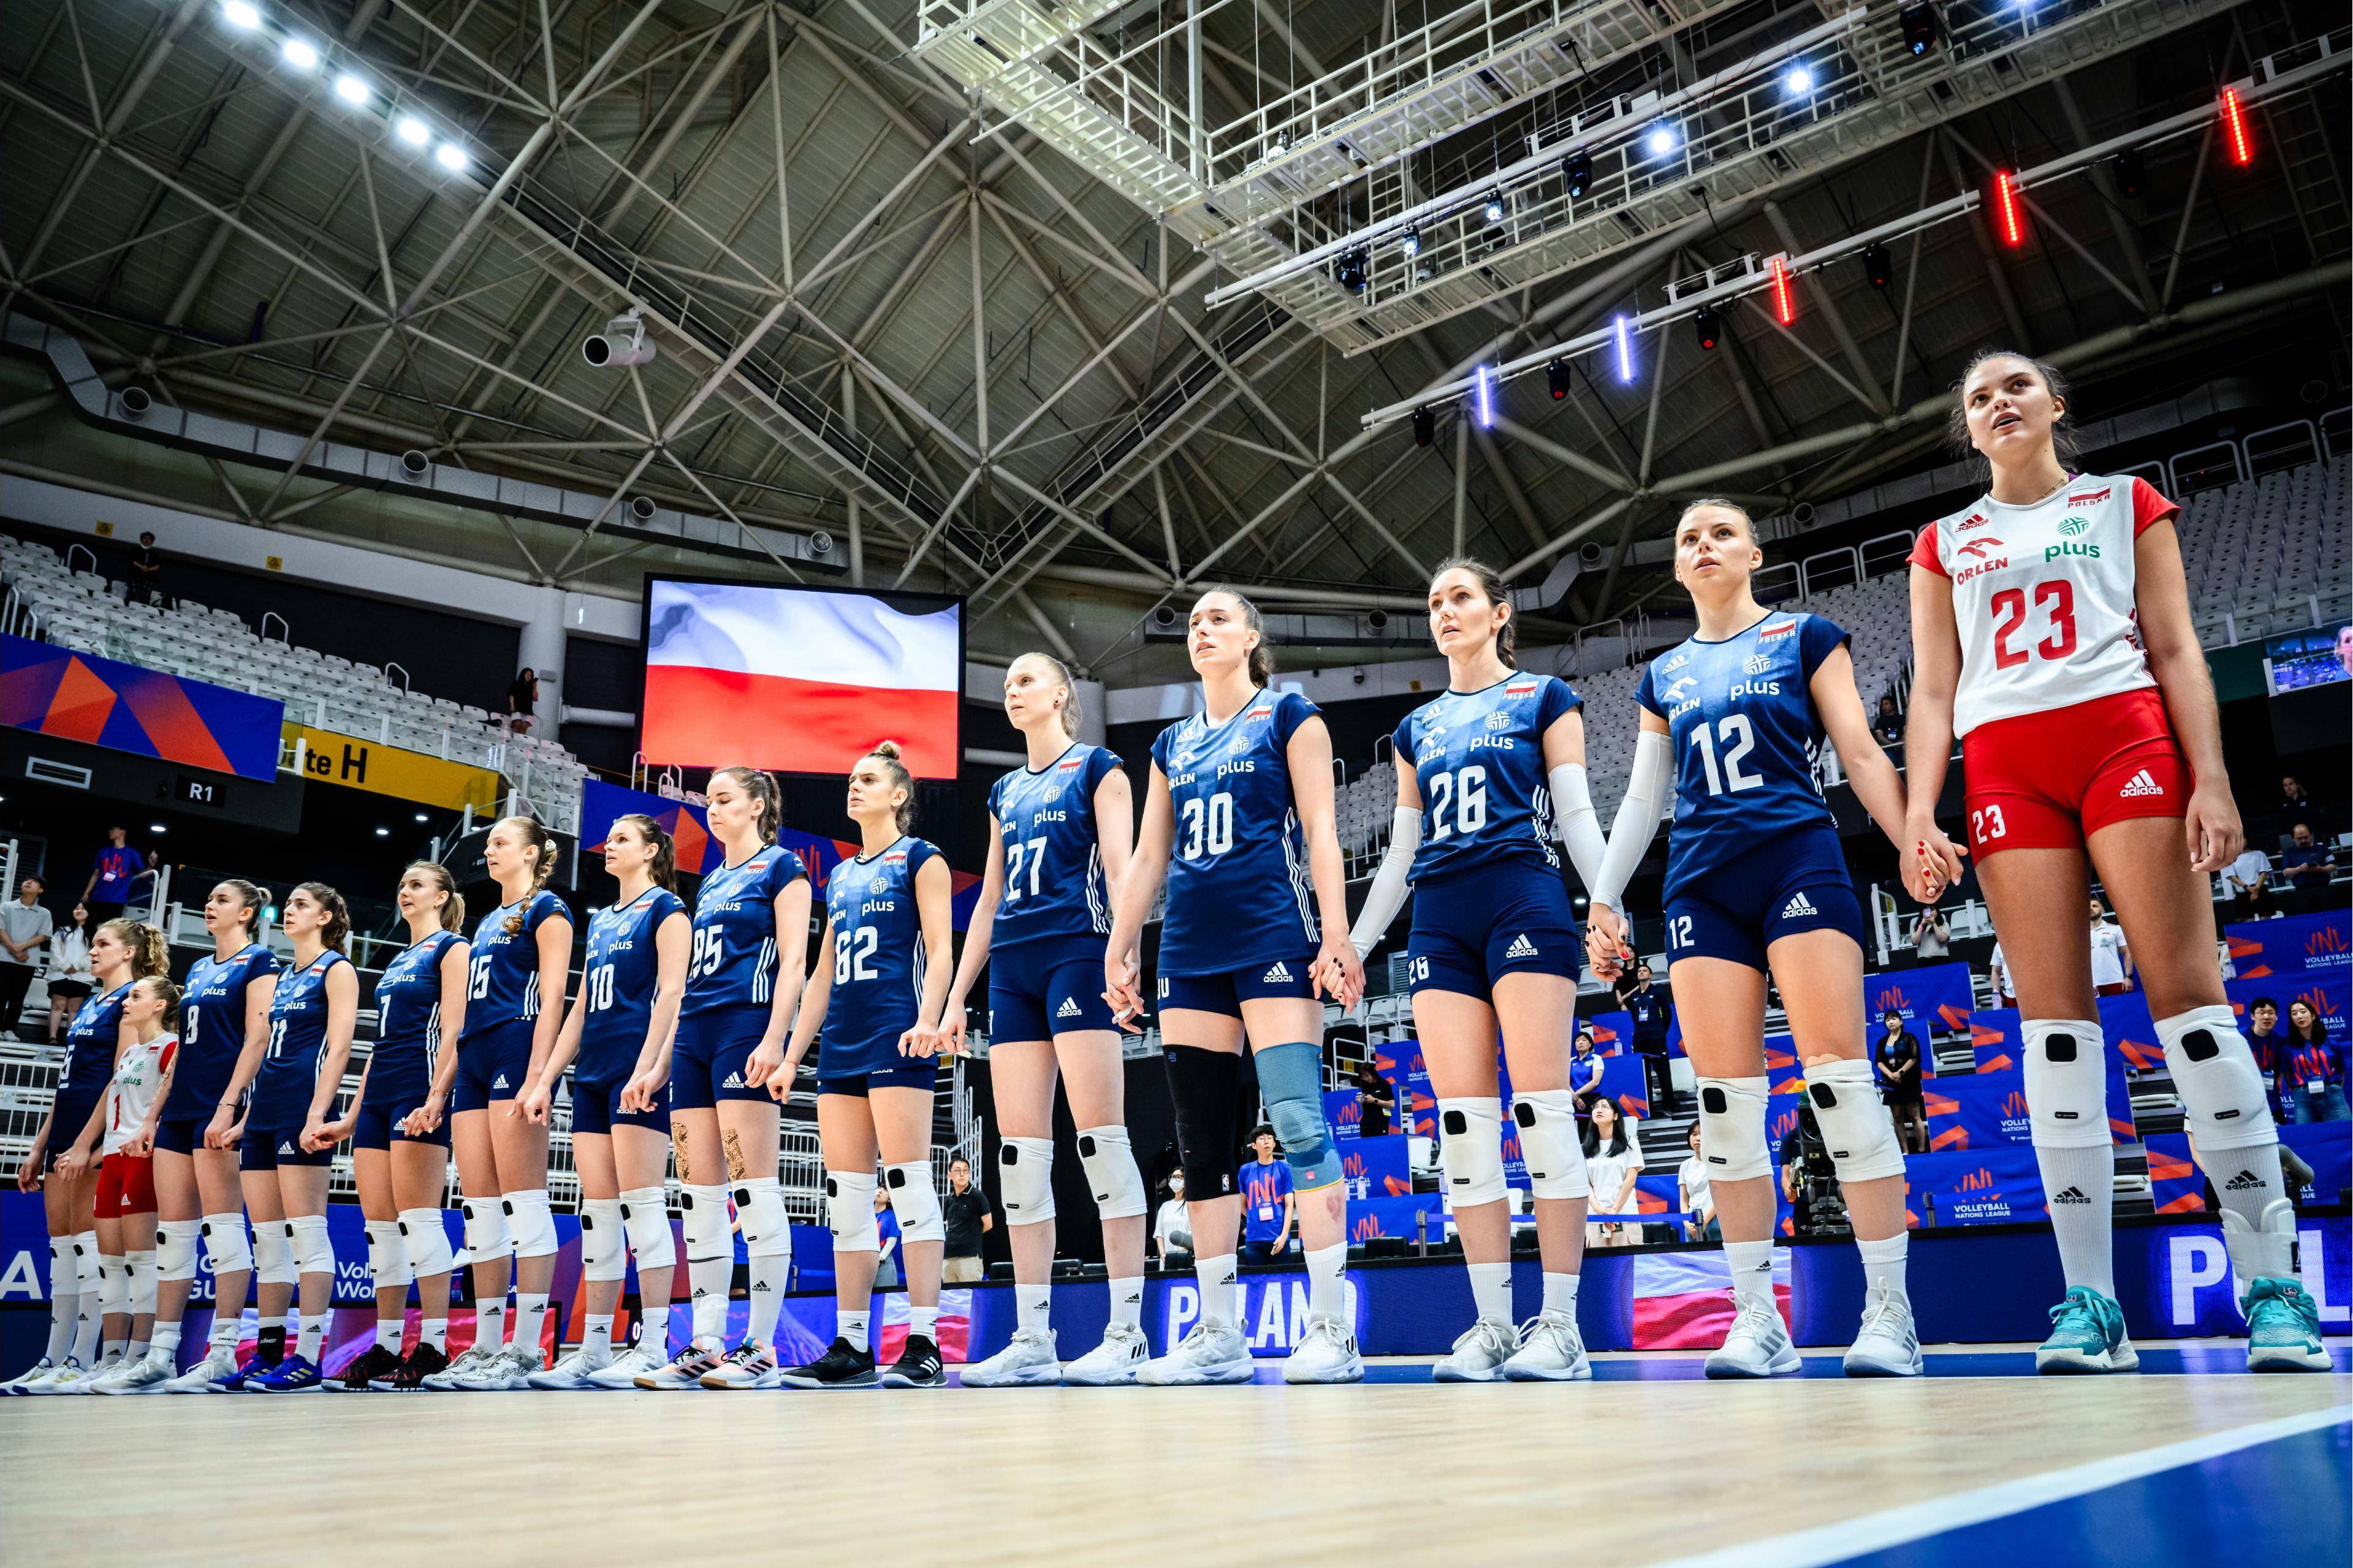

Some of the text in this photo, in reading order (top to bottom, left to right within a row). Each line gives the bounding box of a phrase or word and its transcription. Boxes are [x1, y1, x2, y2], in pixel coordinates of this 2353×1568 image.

[2067, 493, 2111, 509] POLSKA
[1955, 518, 1990, 534] adidas
[2045, 541, 2100, 562] plus
[1957, 557, 2008, 585] ORLEN
[1990, 579, 2077, 670] 23
[1758, 630, 1796, 645] POLSKA
[1662, 660, 1690, 675] adidas
[1730, 680, 1780, 701] plus
[1470, 733, 1514, 752] plus
[341, 743, 368, 784] H
[1416, 746, 1446, 771] ORLEN
[1690, 713, 1764, 797] 12
[1217, 758, 1255, 779] plus
[189, 782, 212, 801] R1
[1168, 772, 1195, 792] ORLEN
[2119, 786, 2163, 797] adidas
[1429, 765, 1486, 842] 26
[1034, 809, 1066, 827] plus
[1182, 792, 1233, 861] 30
[1972, 804, 2006, 845] 23
[1006, 836, 1047, 901] 27
[713, 901, 742, 915] plus
[862, 899, 895, 916] plus
[1782, 906, 1817, 918] adidas
[488, 934, 512, 947] plus
[1669, 915, 1695, 950] 12
[2305, 926, 2350, 955] VNL
[608, 940, 633, 955] plus
[693, 925, 723, 979] 95
[835, 926, 878, 985] 62
[1506, 948, 1538, 958] adidas
[393, 974, 416, 983] plus
[468, 954, 493, 1001] 15
[1263, 974, 1294, 983] adidas
[1408, 956, 1429, 987] 26
[201, 986, 227, 998] plus
[589, 963, 615, 1013] 10
[1875, 985, 1910, 1011] VNL
[284, 1000, 306, 1012] plus
[380, 994, 391, 1037] 7
[1057, 1008, 1082, 1018] adidas
[75, 1028, 94, 1037] plus
[267, 1019, 287, 1059] 11
[123, 1075, 142, 1086] plus
[114, 1093, 120, 1131] 1
[2225, 1180, 2267, 1191] adidas
[1954, 1202, 2010, 1213] VOLLEYBALL
[2053, 1195, 2091, 1205] adidas
[1168, 1279, 1357, 1349] PLAN
